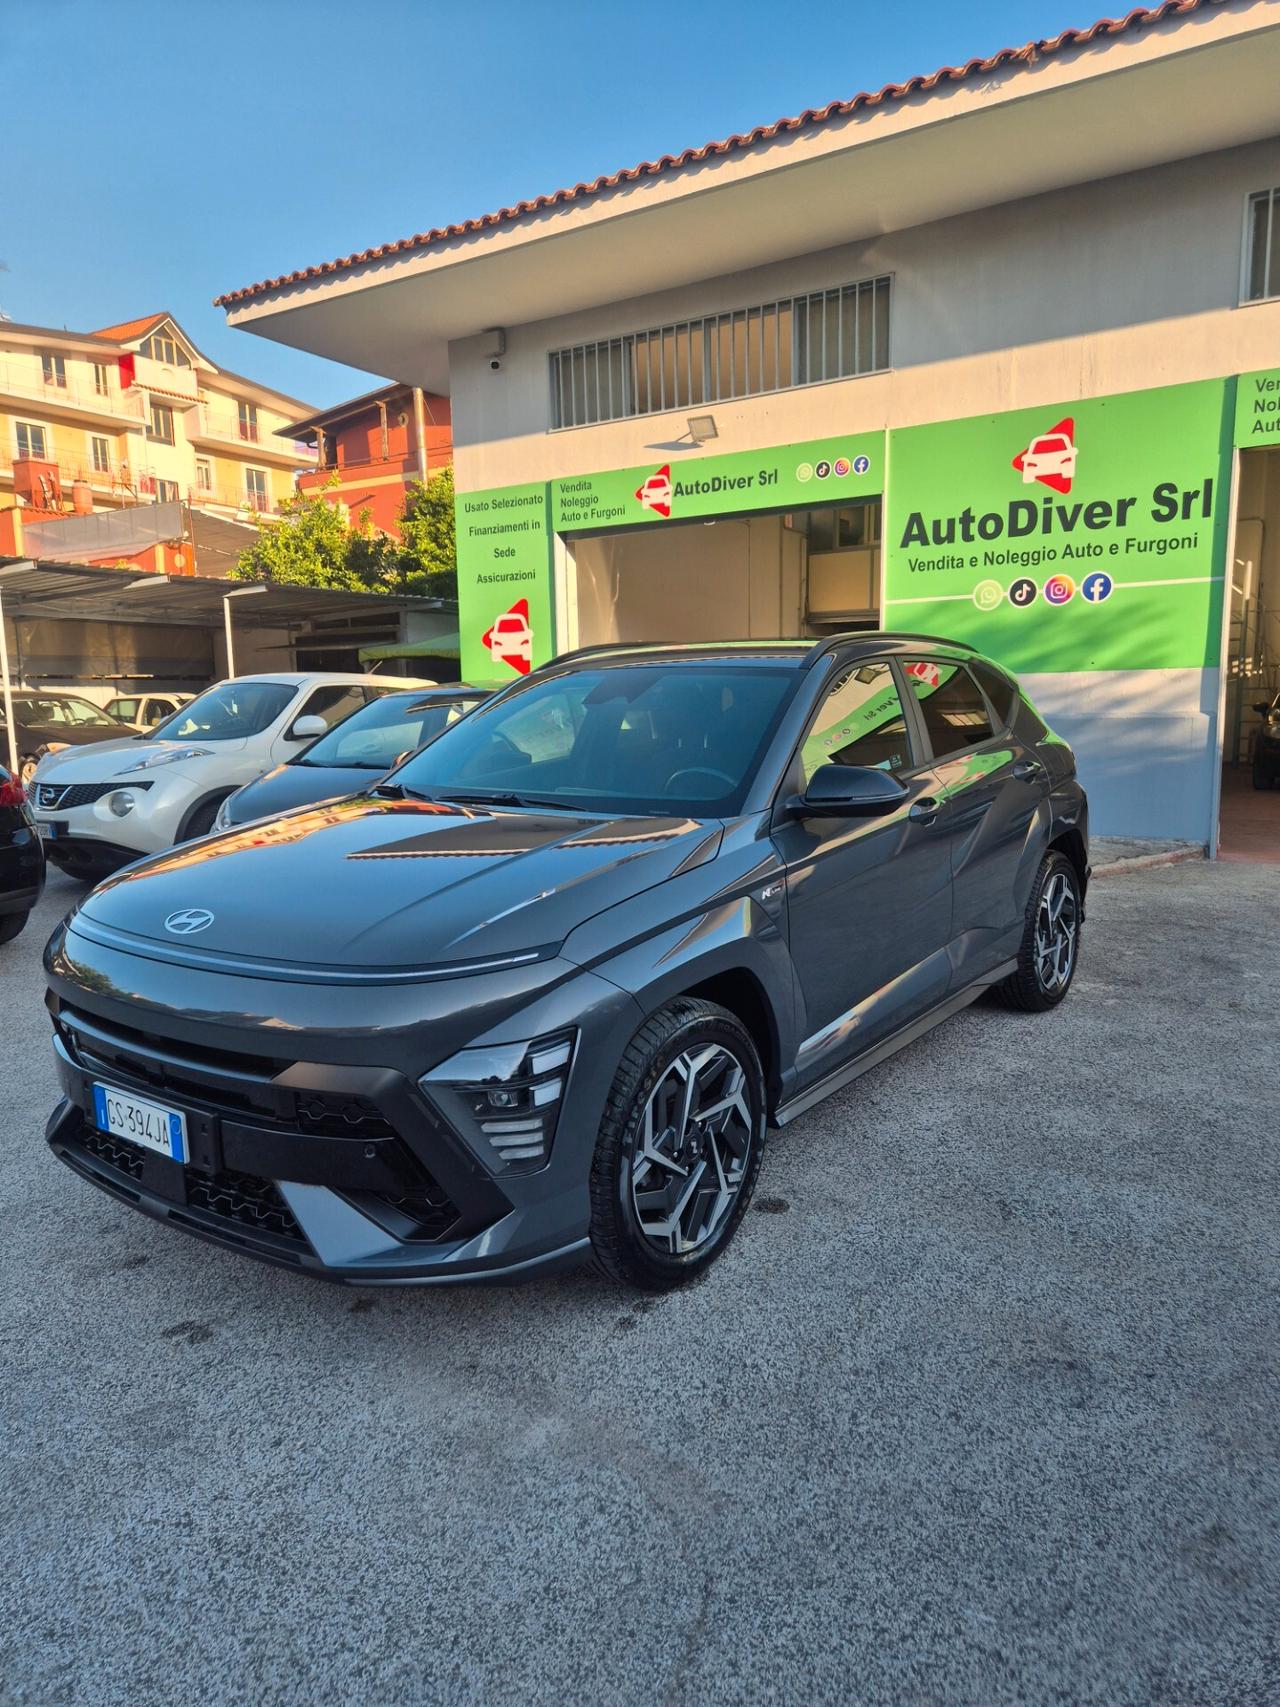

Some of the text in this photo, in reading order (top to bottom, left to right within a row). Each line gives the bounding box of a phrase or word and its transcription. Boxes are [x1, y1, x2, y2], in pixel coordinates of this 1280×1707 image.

[560, 480, 593, 494] Vendita
[673, 469, 779, 497] AutoDiver Srl
[464, 494, 543, 513] Usato Selezionato
[560, 495, 599, 509] Noleggio
[560, 505, 626, 523] Auto e Furgoni
[900, 478, 1214, 549] AutoDiver Srl
[469, 519, 541, 537] Finanziamenti in
[493, 547, 516, 559] Sede
[908, 532, 1199, 573] Vendita e Noleggio Auto e Furgoni
[476, 569, 536, 584] Assicurazioni
